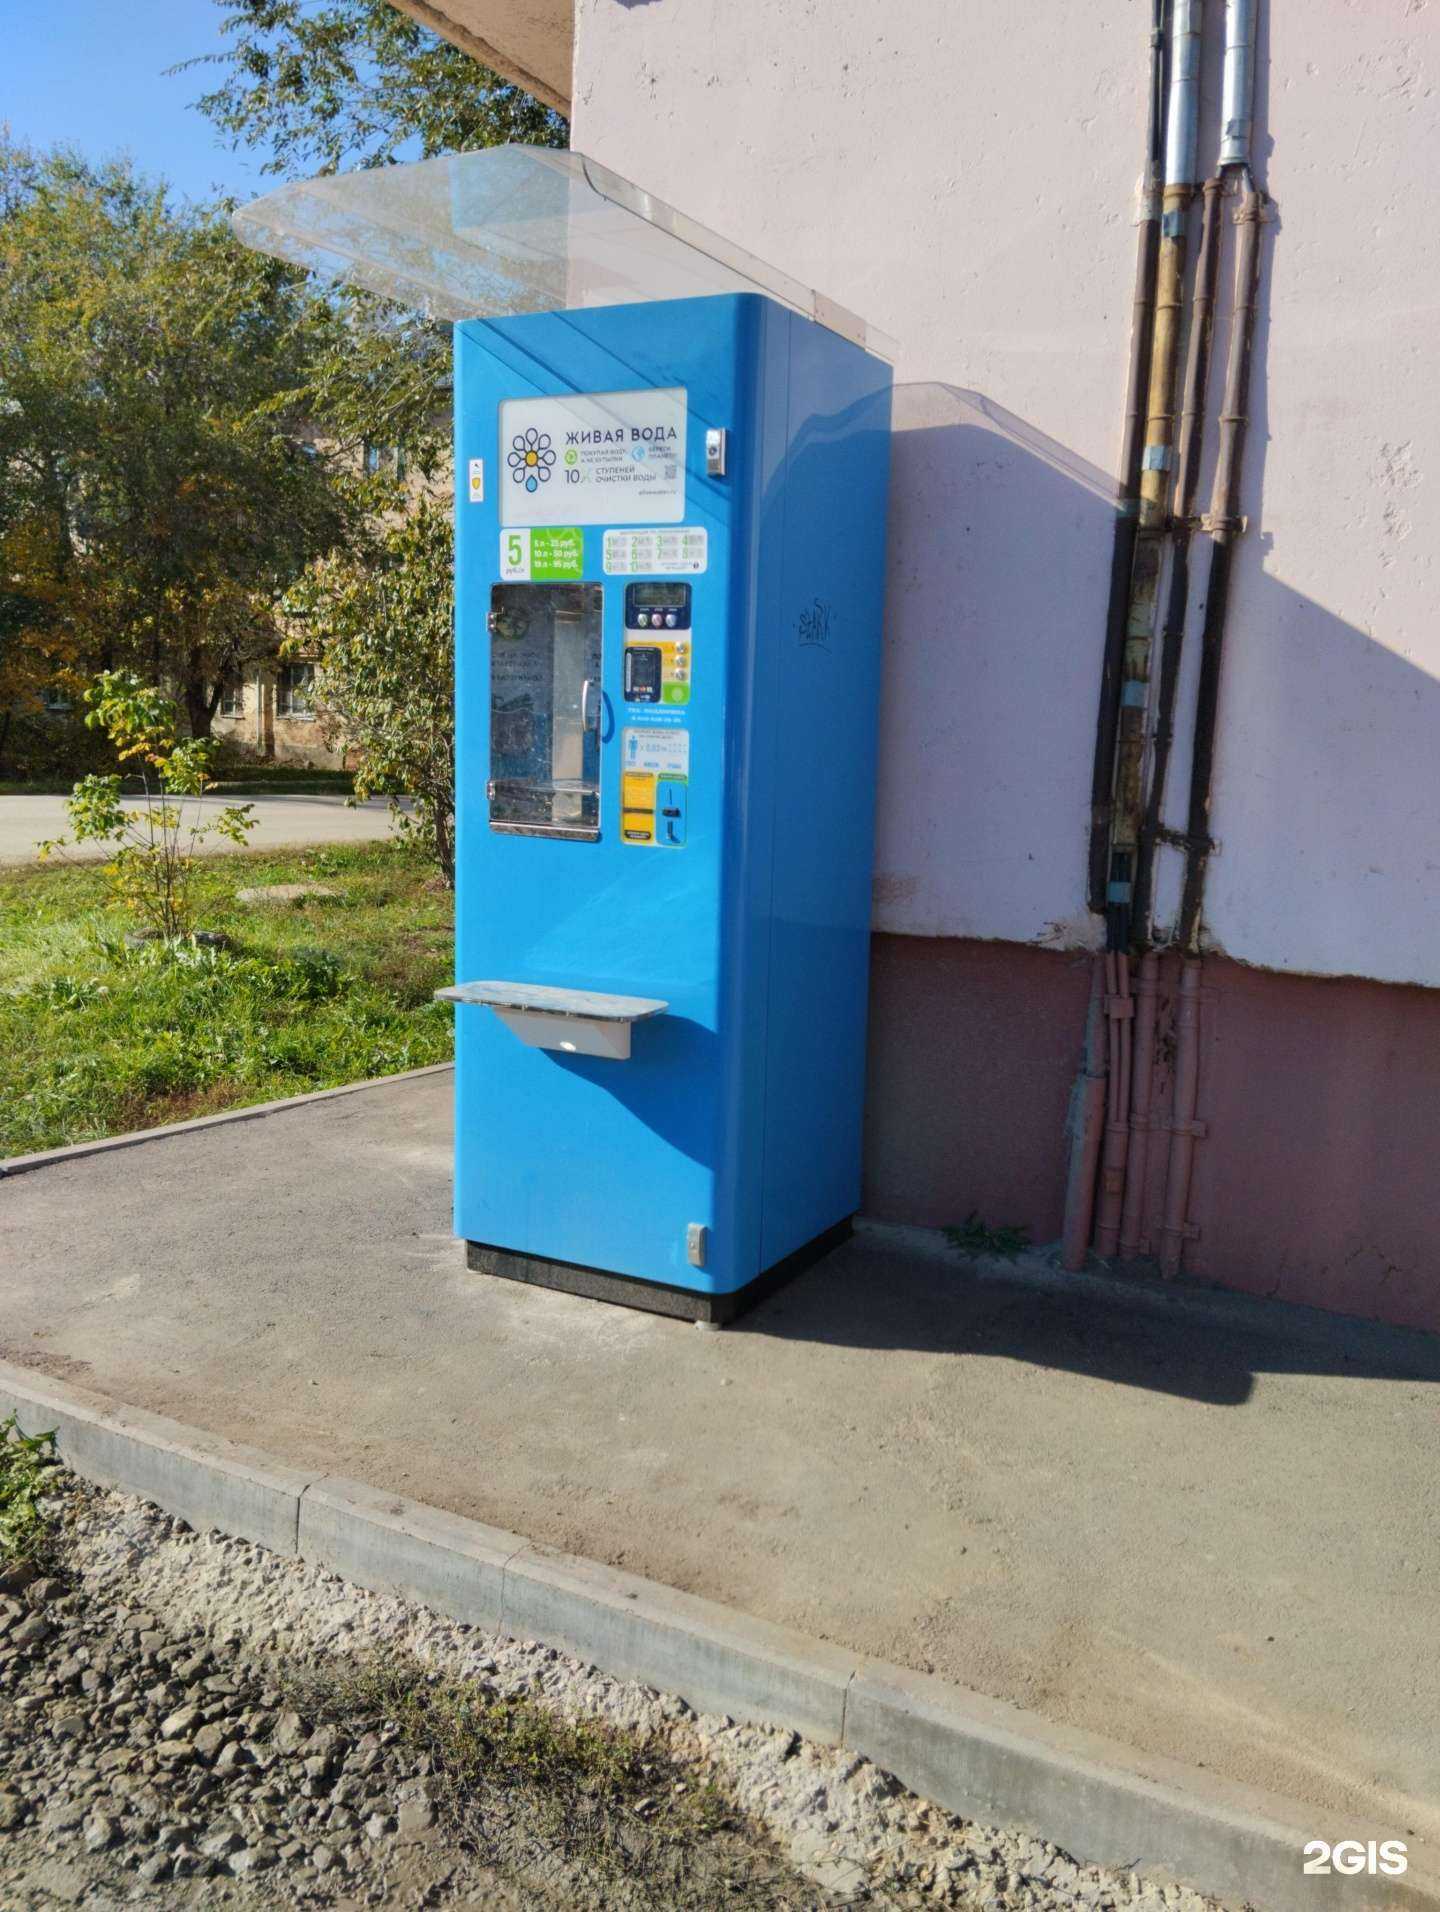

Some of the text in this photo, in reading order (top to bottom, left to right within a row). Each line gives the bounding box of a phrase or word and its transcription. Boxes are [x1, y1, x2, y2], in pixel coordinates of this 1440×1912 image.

[565, 426, 677, 445] ЖИВАЯ ВОДА
[595, 466, 635, 476] СТУПЕНЕЙ
[595, 474, 631, 483] ОЧИСТКИ
[508, 534, 522, 566] 5
